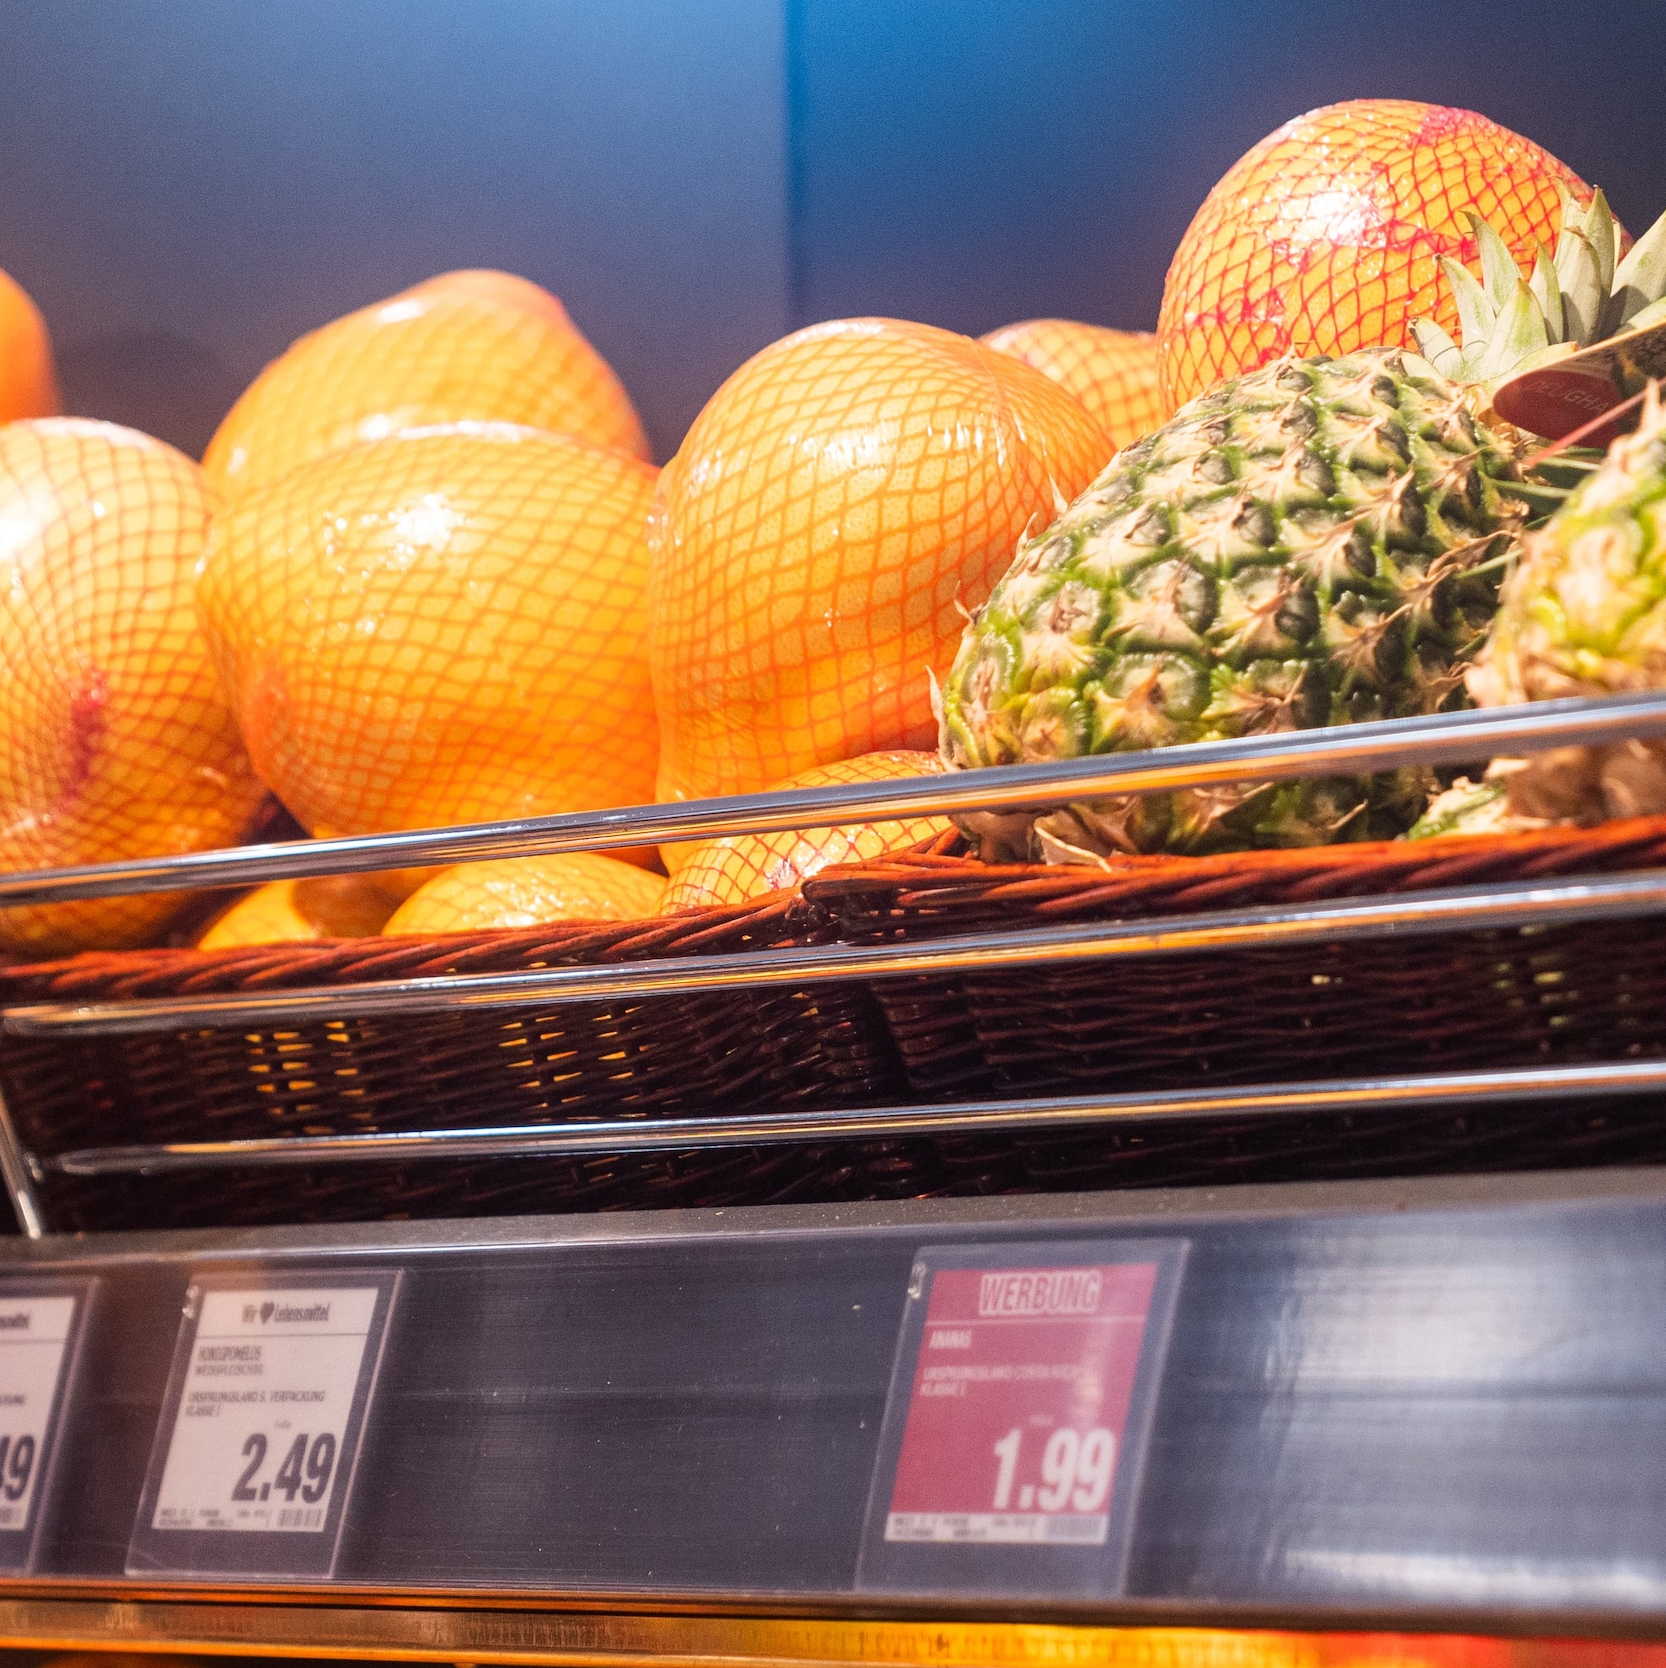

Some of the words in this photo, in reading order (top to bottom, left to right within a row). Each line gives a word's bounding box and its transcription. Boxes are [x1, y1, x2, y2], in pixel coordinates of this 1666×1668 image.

[983, 1275, 1099, 1312] WERBUNG
[231, 1432, 337, 1504] 2.49
[992, 1427, 1115, 1511] 1.99
